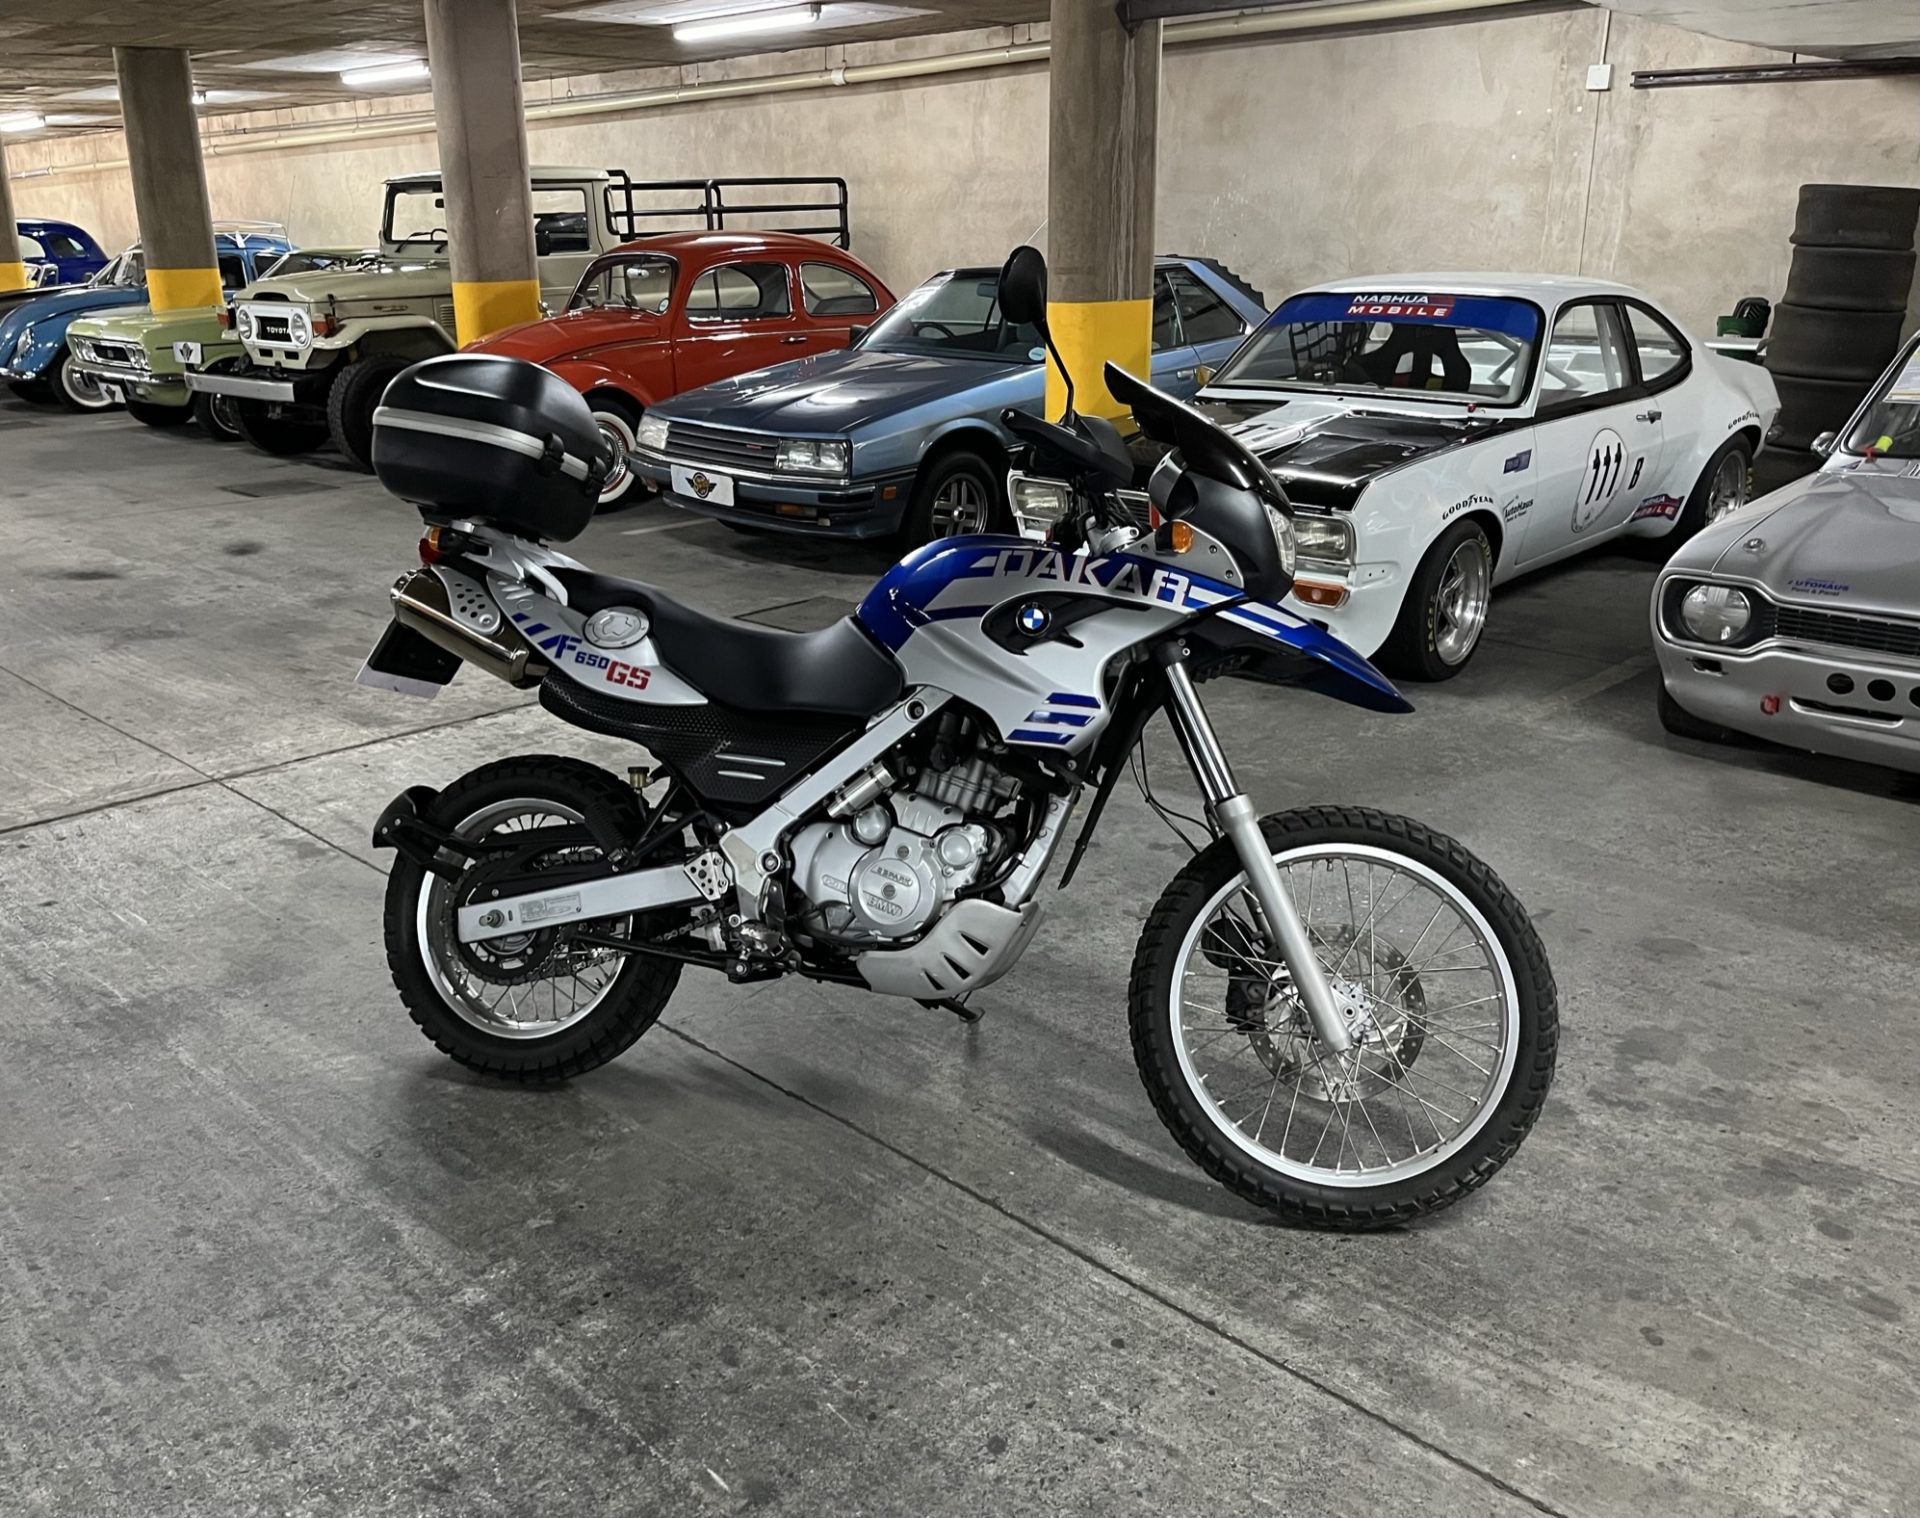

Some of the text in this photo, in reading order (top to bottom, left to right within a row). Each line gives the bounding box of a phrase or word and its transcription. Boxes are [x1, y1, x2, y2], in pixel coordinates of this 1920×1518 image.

[1347, 305, 1448, 317] MOBILE
[1353, 295, 1429, 304] NASHUA
[1585, 442, 1622, 505] 111
[1442, 494, 1494, 520] GOODYEAR
[993, 550, 1191, 608] DAKAR
